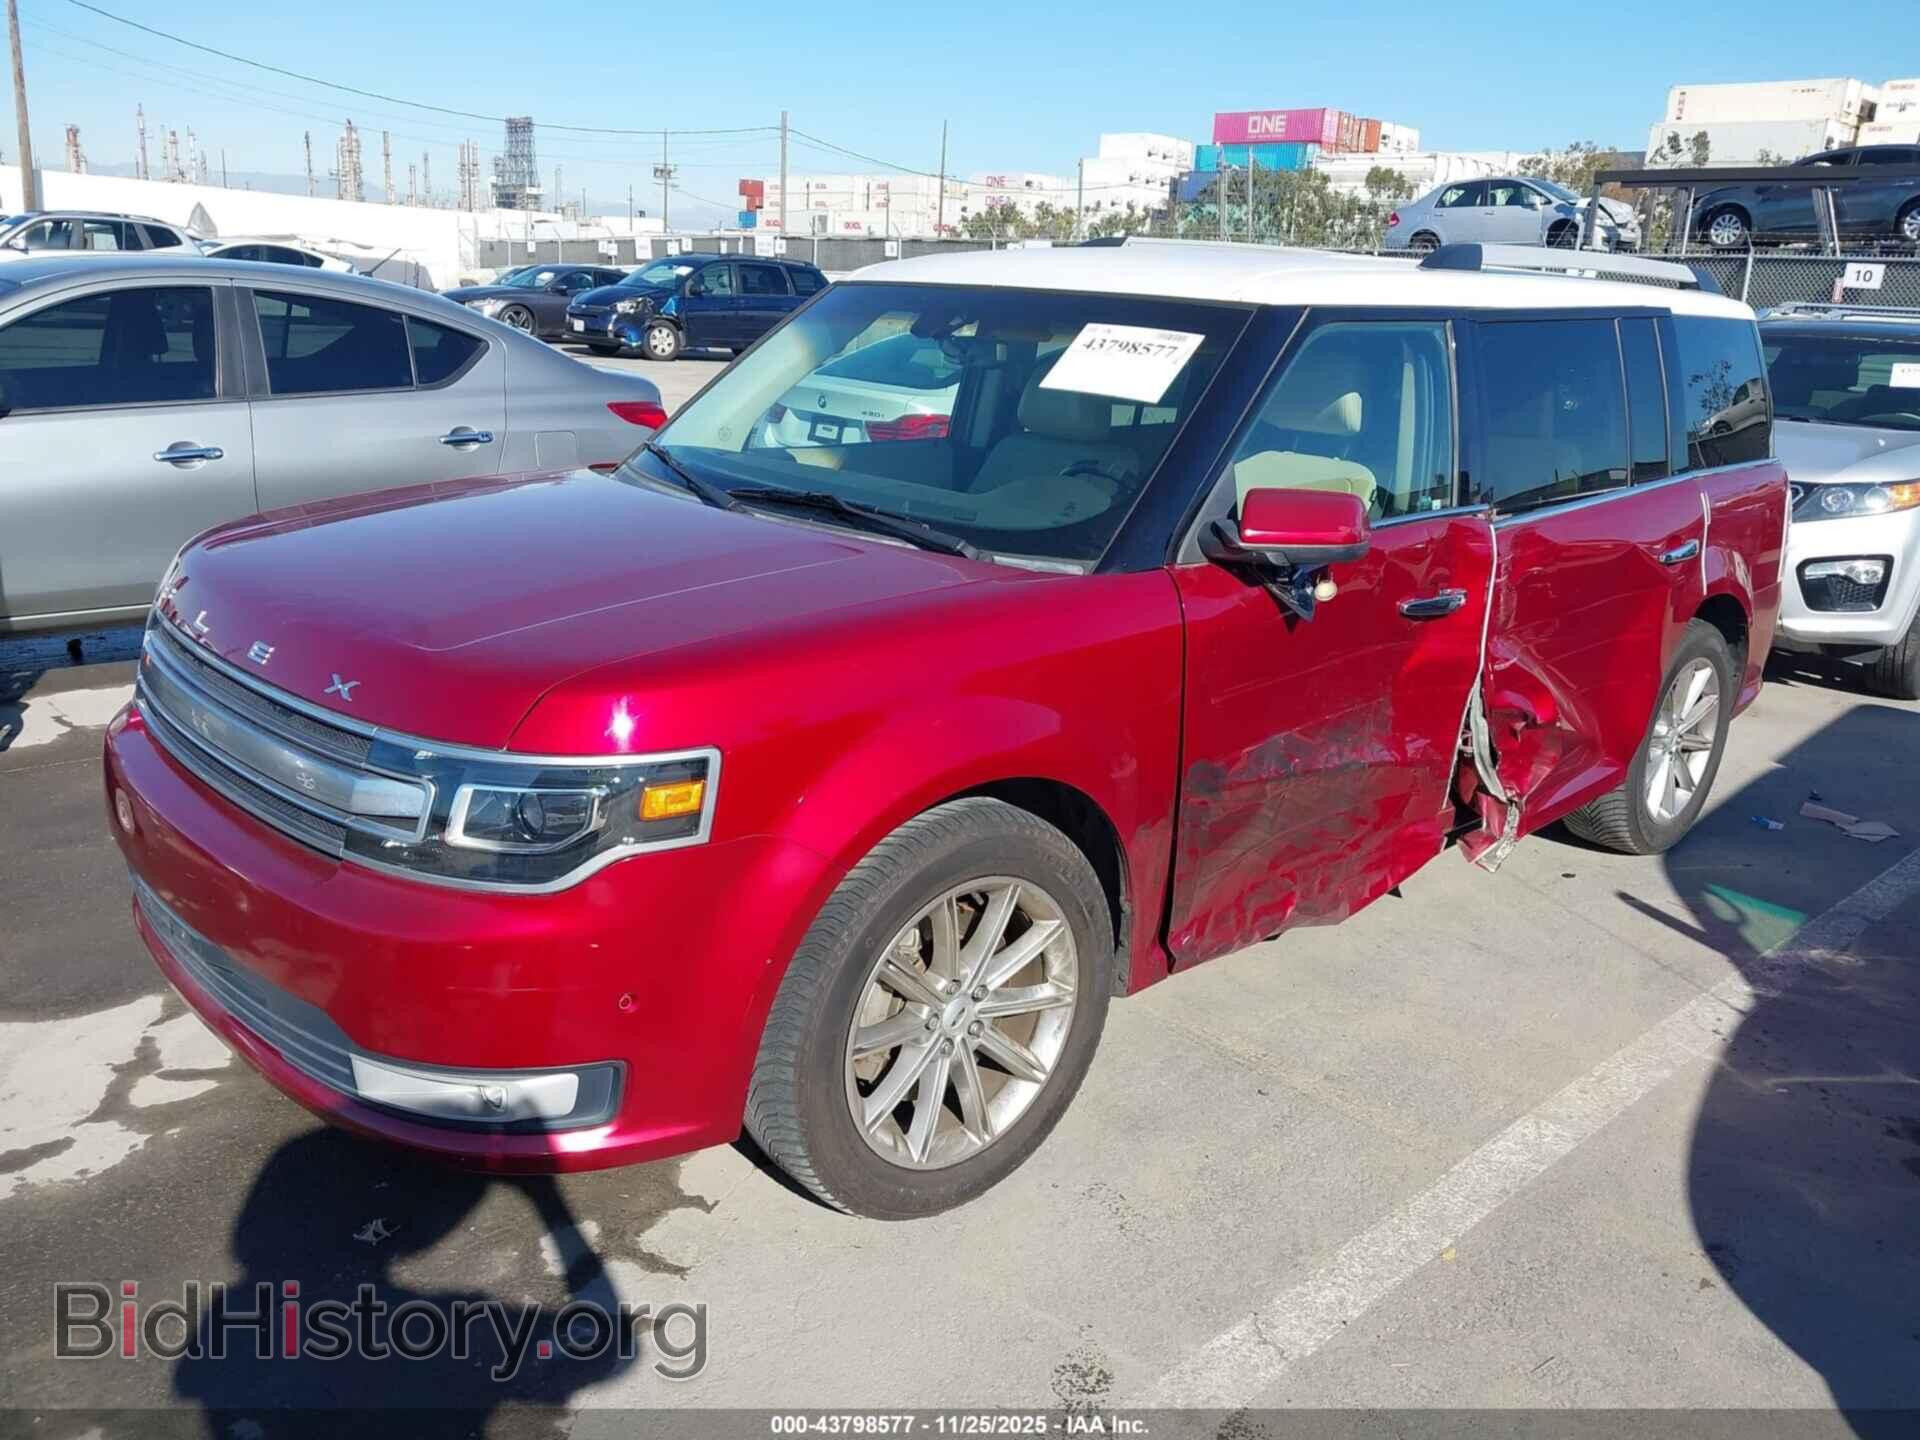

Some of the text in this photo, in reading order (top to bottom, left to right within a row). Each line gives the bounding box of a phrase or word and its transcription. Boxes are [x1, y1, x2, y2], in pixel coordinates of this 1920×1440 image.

[1248, 113, 1286, 134] ONE
[985, 175, 1006, 187] ONE
[1855, 269, 1873, 282] 10
[1083, 337, 1179, 358] 43798577
